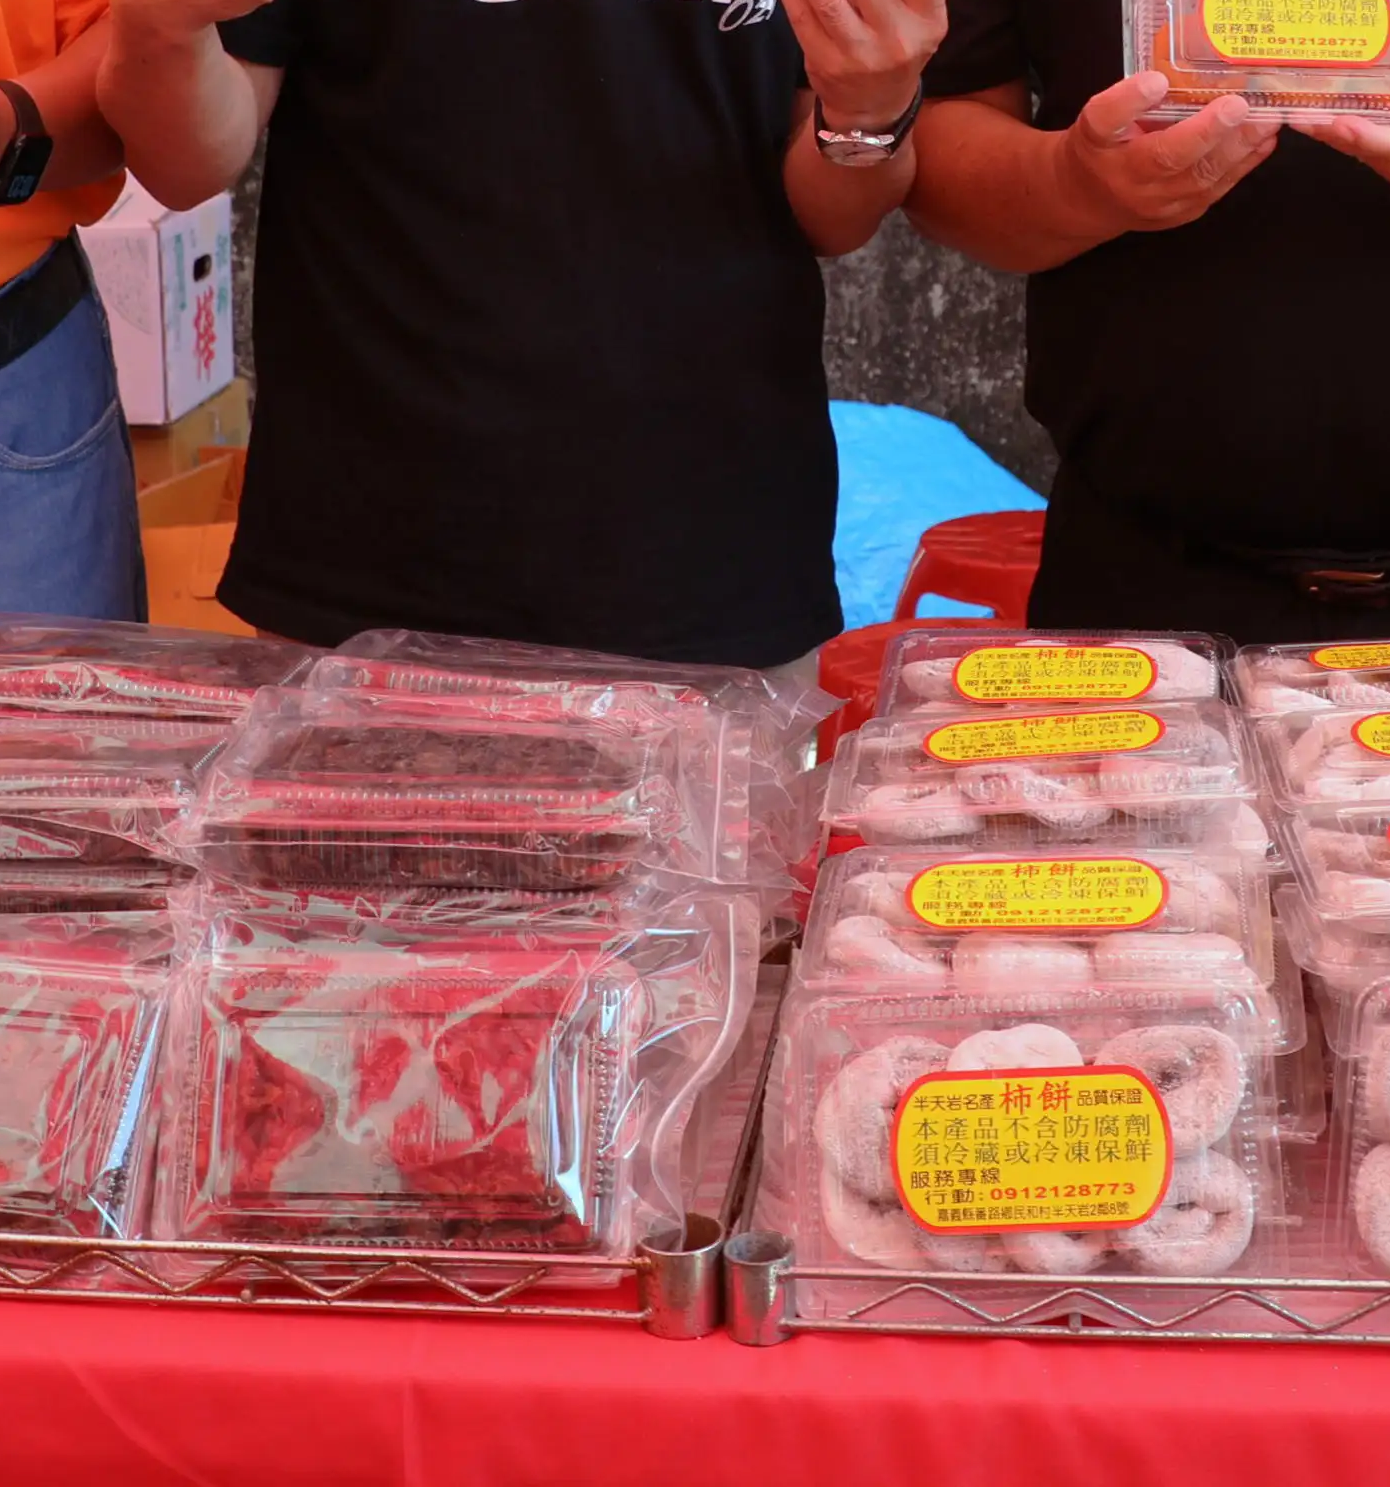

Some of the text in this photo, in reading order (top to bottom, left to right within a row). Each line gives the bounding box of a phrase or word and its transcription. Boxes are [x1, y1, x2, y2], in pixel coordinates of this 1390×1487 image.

[1213, 24, 1275, 34] 服務專線
[1267, 37, 1368, 47] 0912128773
[1035, 649, 1086, 661] 柿餅
[1011, 863, 1078, 879] 柿餅
[996, 907, 1134, 916] 0912128773
[914, 1080, 1143, 1115] 半天岩名產 柿餅 品質保證
[912, 1114, 1151, 1141] 本產品不含防腐劑
[912, 1139, 1153, 1166] 須冷藏或冷凍保鮮
[911, 1168, 1001, 1189] 服務專線
[924, 1182, 1136, 1206] 行動: 0912128773
